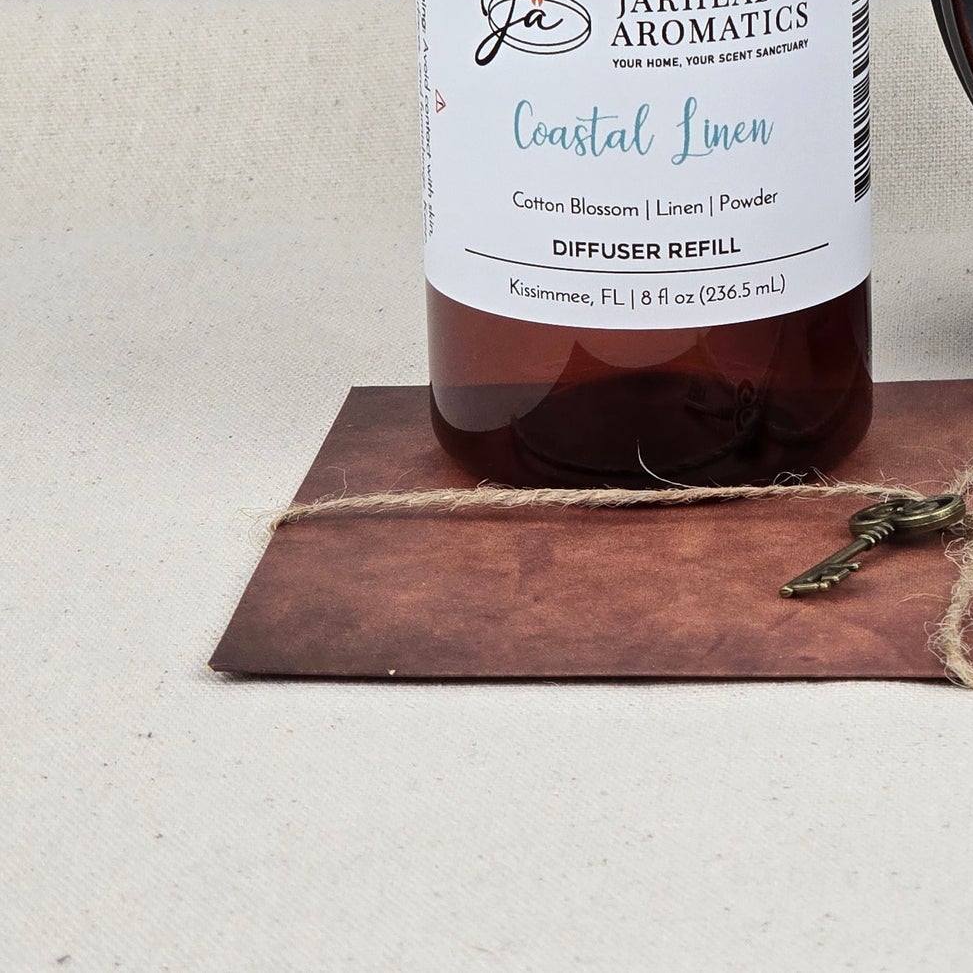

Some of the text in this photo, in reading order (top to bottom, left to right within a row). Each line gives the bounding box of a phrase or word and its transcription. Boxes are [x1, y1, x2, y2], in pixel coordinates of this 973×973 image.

[610, 1, 809, 48] AROMATICS
[612, 38, 809, 69] YOUR HOME, YOUR SCENT SANCTUARY
[513, 96, 775, 166] Coastal Linen
[512, 190, 565, 214] Cotton
[570, 195, 639, 217] Blossom
[656, 199, 704, 216] Linen
[719, 188, 779, 212] Powder
[552, 236, 742, 260] DIFFUSER REFILL
[509, 278, 594, 307] Kissimmee,
[601, 288, 625, 306] FL
[640, 290, 652, 306] 8
[657, 287, 670, 306] fl
[674, 293, 695, 305] oz
[699, 281, 751, 306] (236.5
[755, 273, 787, 297] mL)
